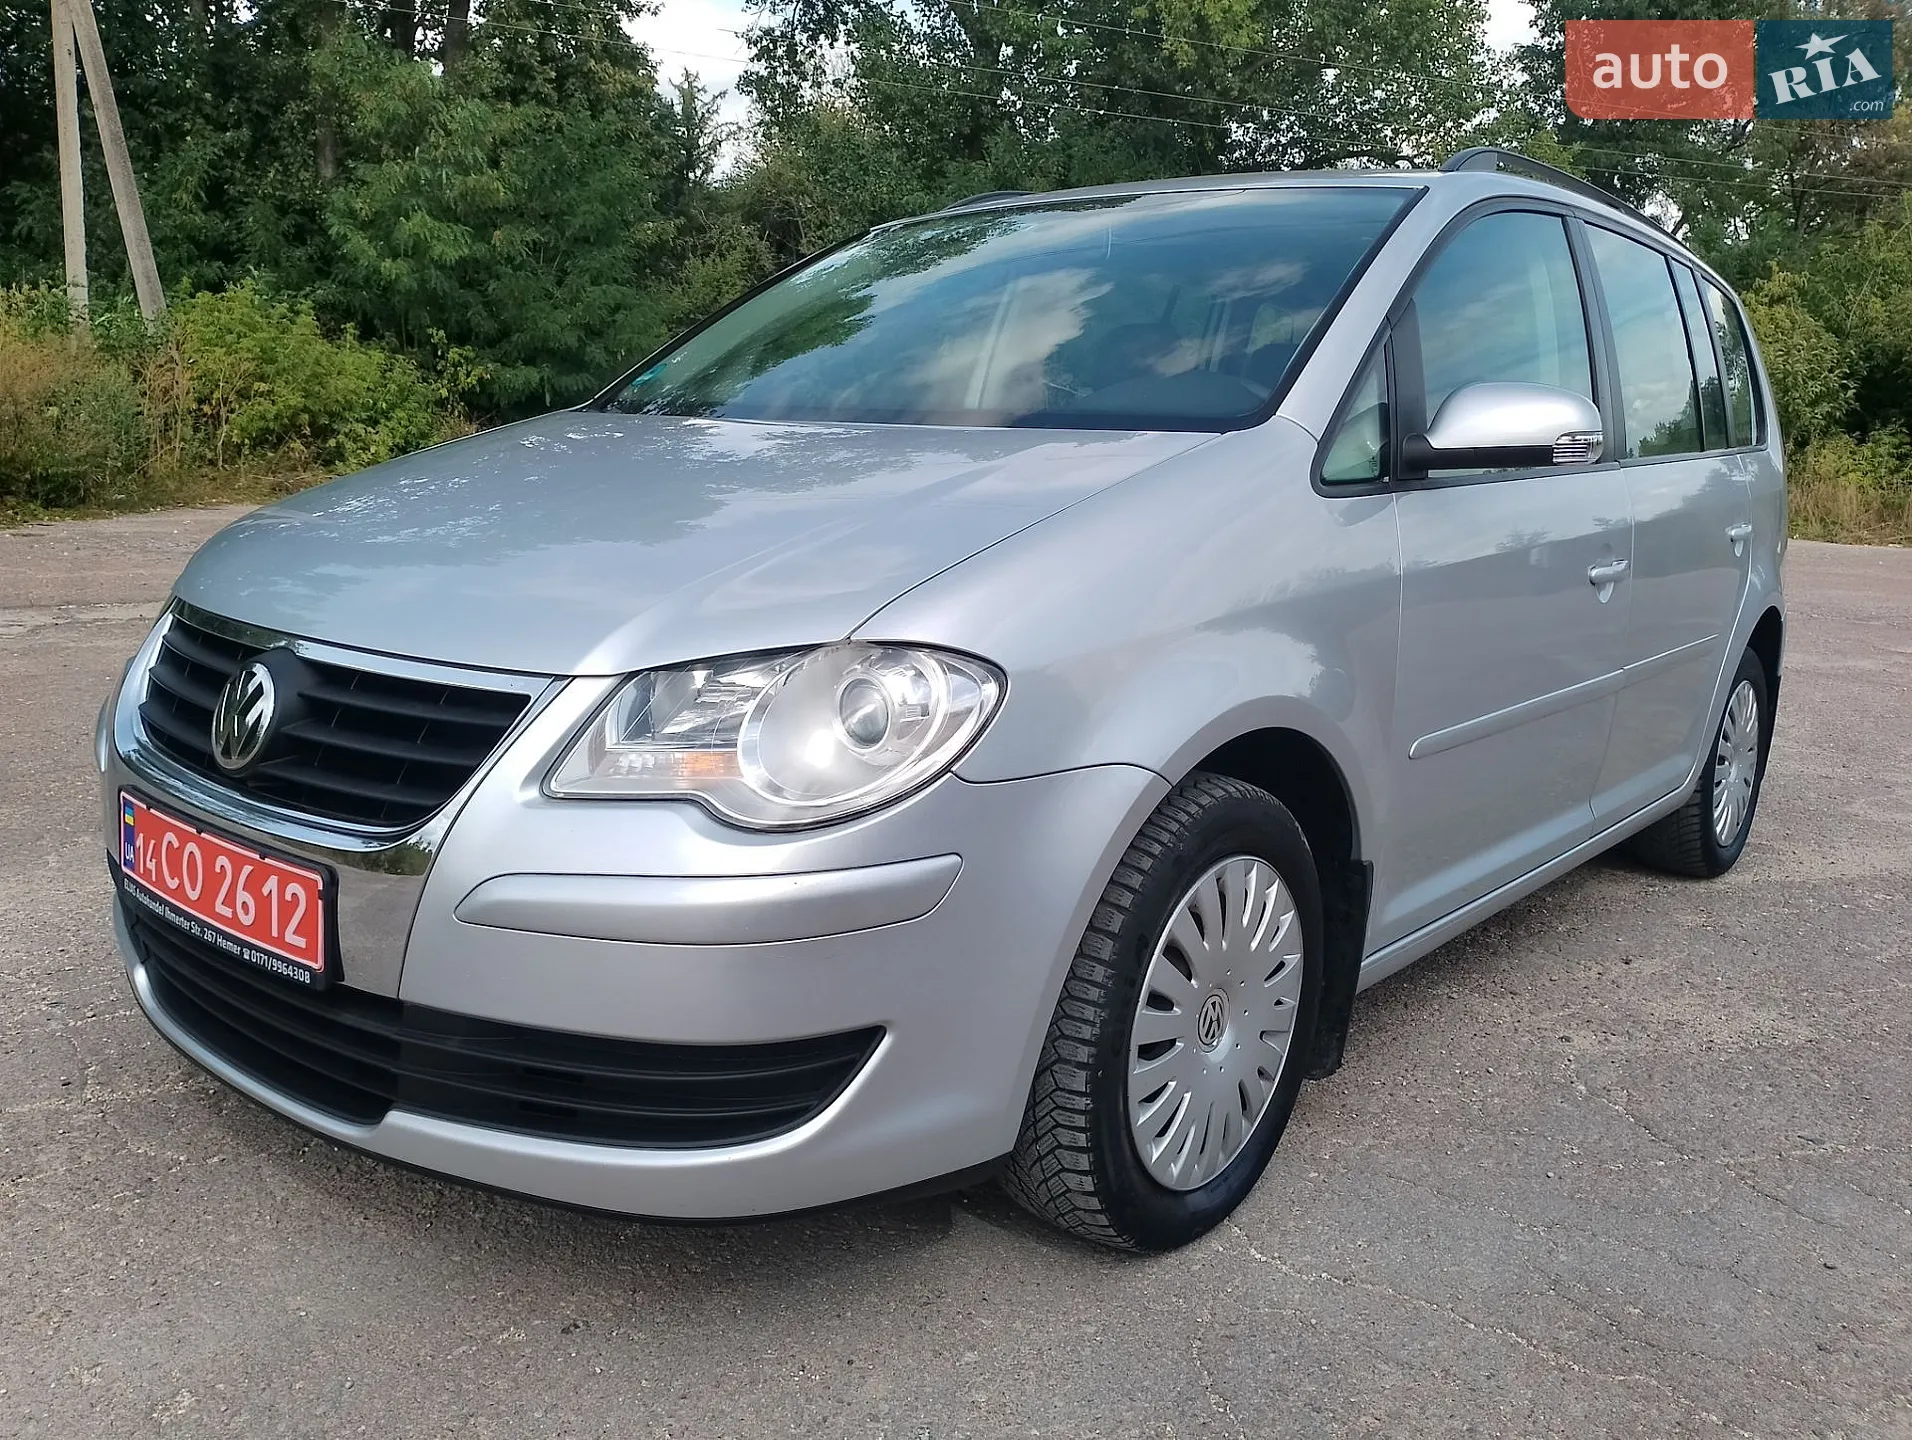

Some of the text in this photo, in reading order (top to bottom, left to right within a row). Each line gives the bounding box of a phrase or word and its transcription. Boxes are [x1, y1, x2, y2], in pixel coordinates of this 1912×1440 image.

[125, 842, 135, 863] UA
[214, 855, 307, 949] 2612
[190, 921, 203, 937] Str.
[203, 927, 216, 944] 267
[216, 933, 242, 956] Hemer
